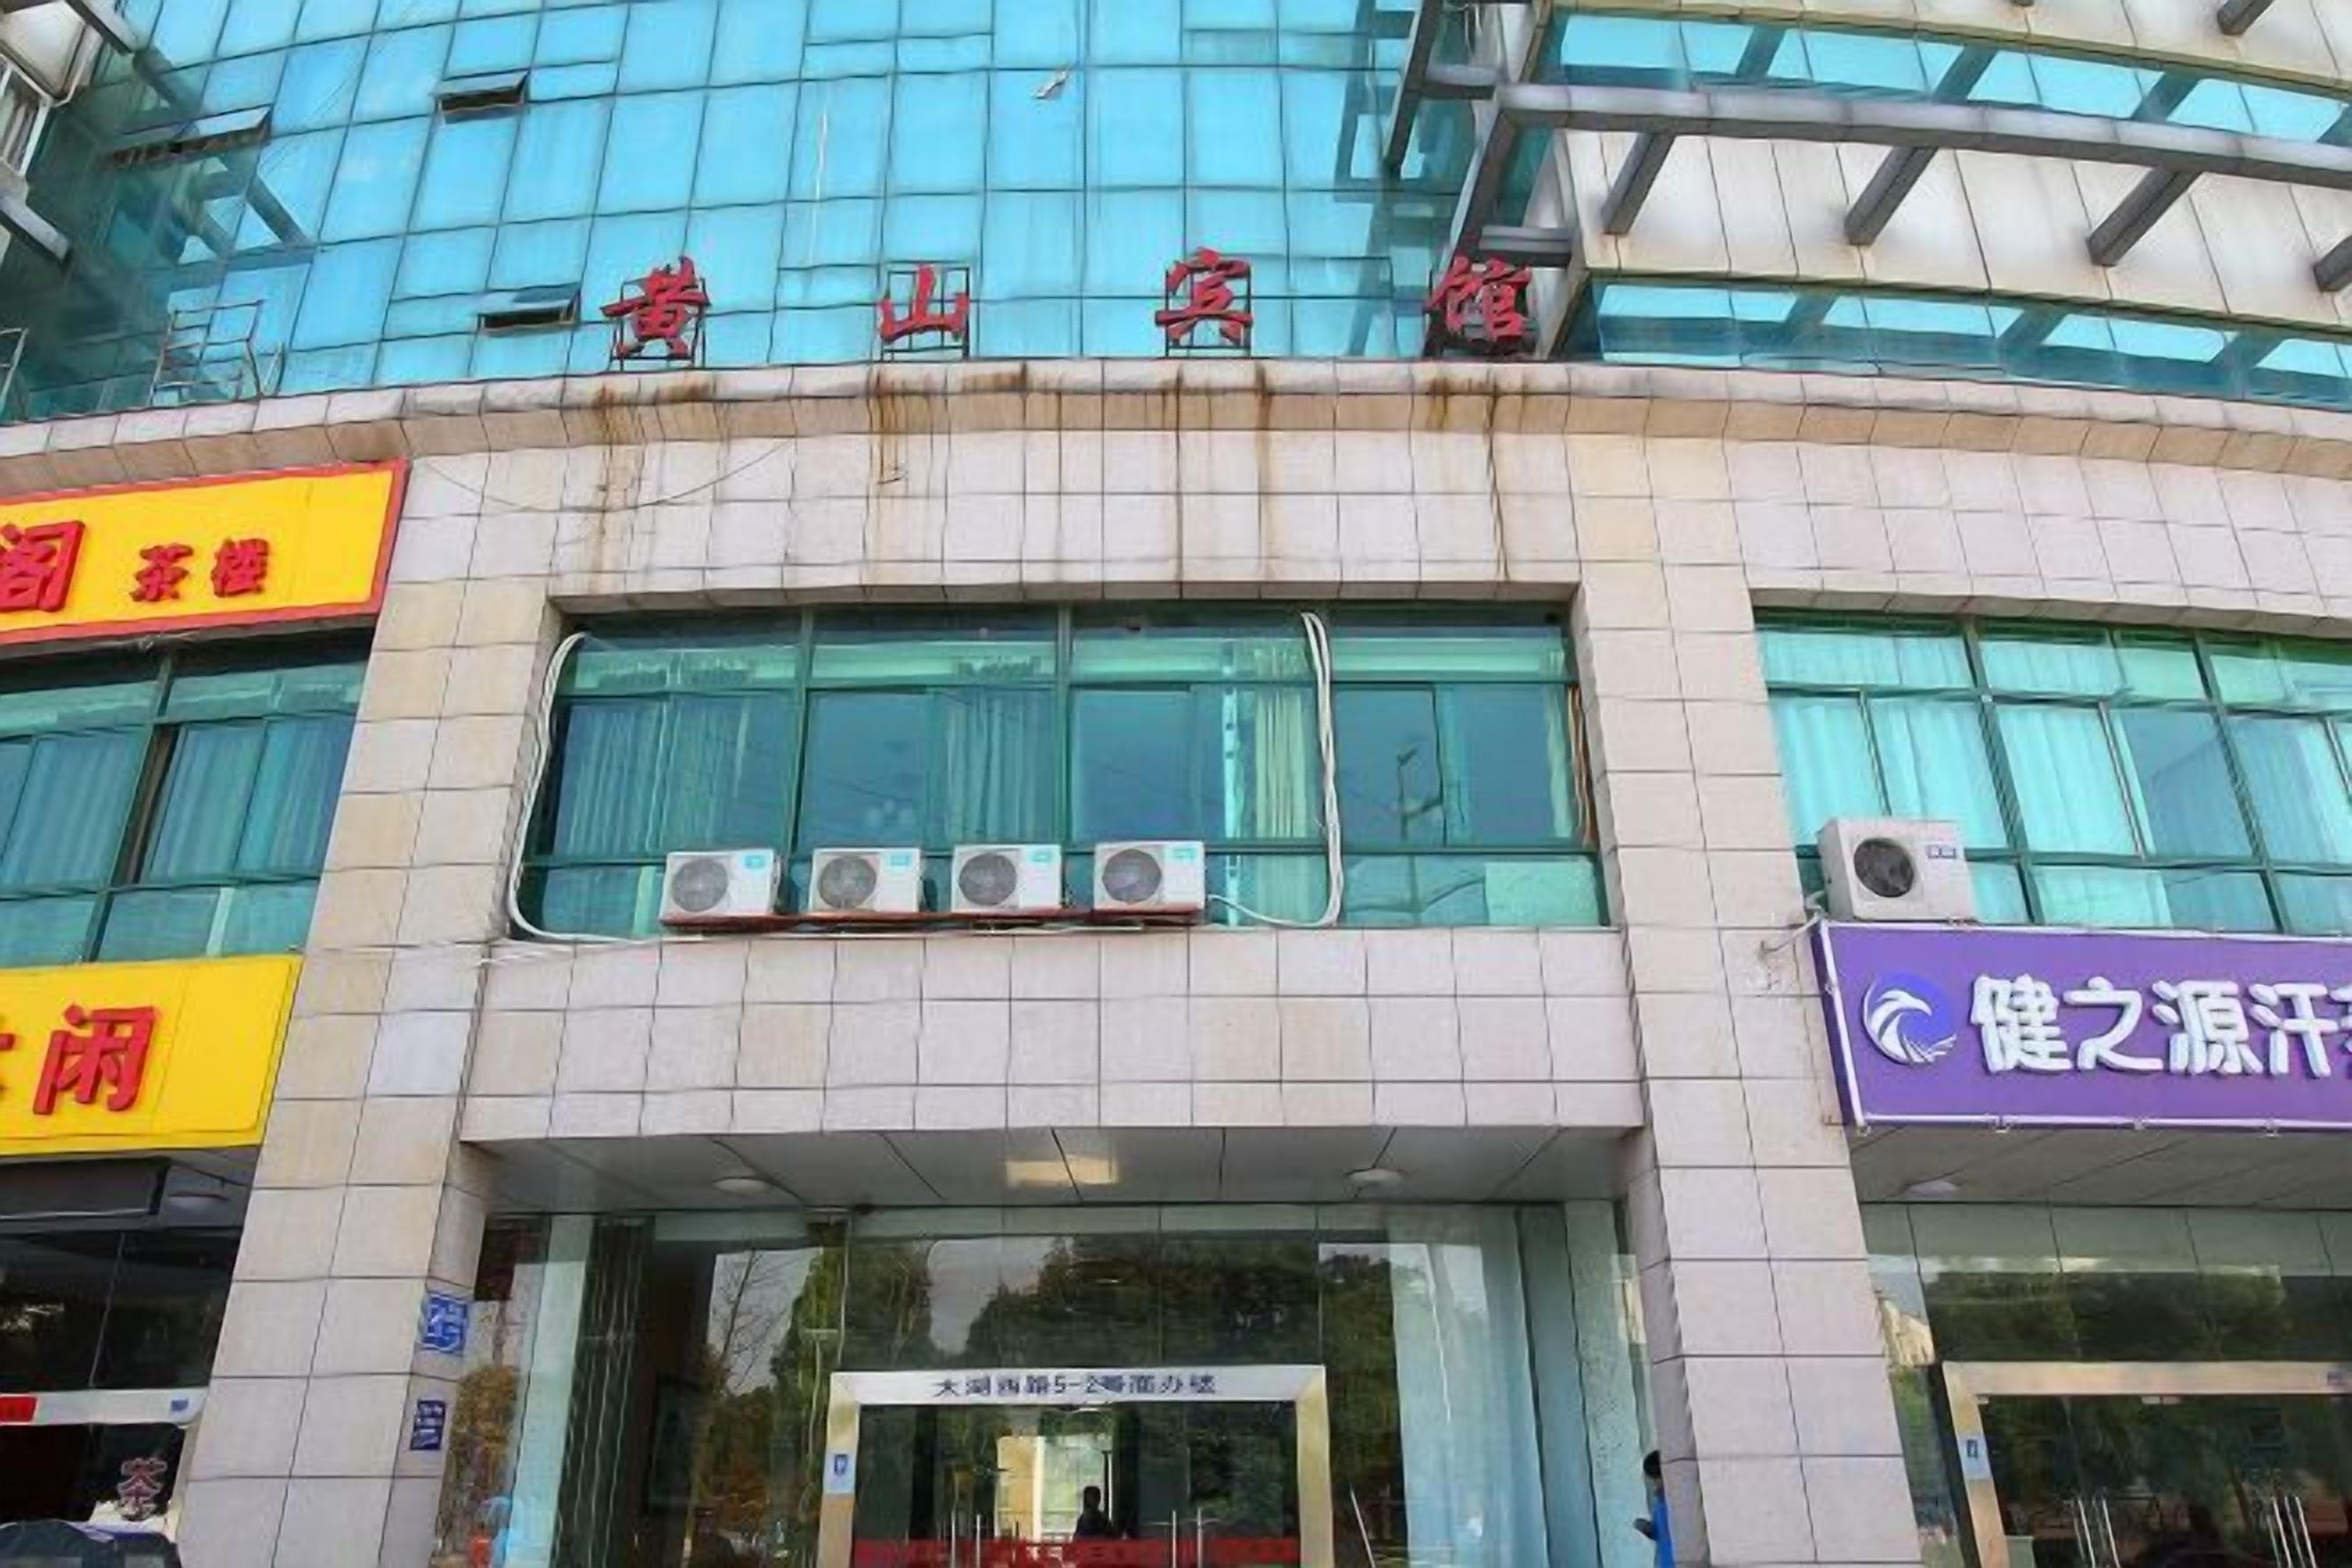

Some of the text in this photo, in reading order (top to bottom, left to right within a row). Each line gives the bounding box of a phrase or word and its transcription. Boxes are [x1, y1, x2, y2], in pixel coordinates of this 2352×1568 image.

[600, 248, 1531, 358] 黄山宾馆
[130, 538, 270, 601] 茶楼
[0, 1004, 154, 1115] 闲
[1971, 974, 2352, 1077] 健之源汗
